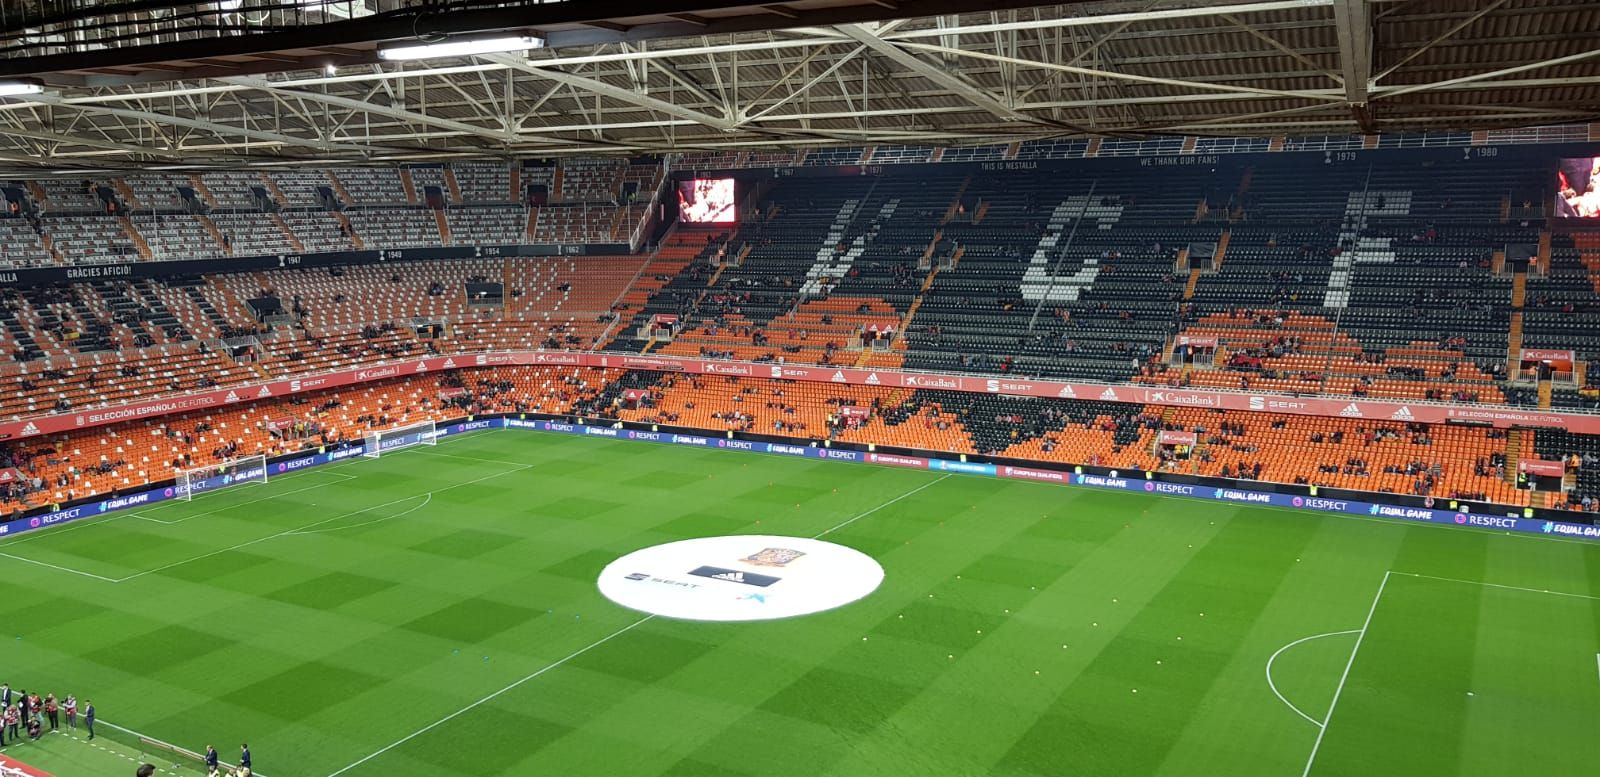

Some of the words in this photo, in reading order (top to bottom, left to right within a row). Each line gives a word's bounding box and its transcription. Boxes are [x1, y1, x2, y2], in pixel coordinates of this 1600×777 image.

[1336, 152, 1357, 161] 1979
[1476, 148, 1498, 157] 1980
[1140, 158, 1153, 166] WE
[1154, 157, 1178, 165] THANK
[1180, 156, 1196, 165] OUR
[67, 264, 101, 279] GRÀCIES
[366, 367, 396, 380] CaixaBank
[715, 363, 748, 375] CaixaBank
[783, 369, 809, 377] SEAT
[303, 378, 327, 387] SEAT
[917, 376, 957, 388] CaixaBank
[1002, 383, 1032, 391] SEAT
[1165, 392, 1214, 406] CaixaBank
[1269, 401, 1307, 409] SEAT
[89, 408, 135, 423] SELECCIÓN
[136, 402, 177, 415] ESPAÑOLA
[178, 401, 189, 409] DE
[1457, 410, 1494, 419] SELECCIÓN
[1494, 412, 1529, 421] ESPAÑOLA
[465, 420, 490, 431] RESPECT
[551, 423, 574, 432] RESPECT
[636, 431, 660, 441] RESPECT
[726, 440, 752, 450] RESPECT
[828, 450, 856, 460] RESPECT
[287, 457, 315, 470] RESPECT
[1156, 483, 1194, 494] RESPECT
[1305, 498, 1348, 511] RESPECT
[42, 508, 81, 524] RESPECT
[1469, 515, 1517, 528] RESPECT
[651, 577, 700, 589] SEAT
